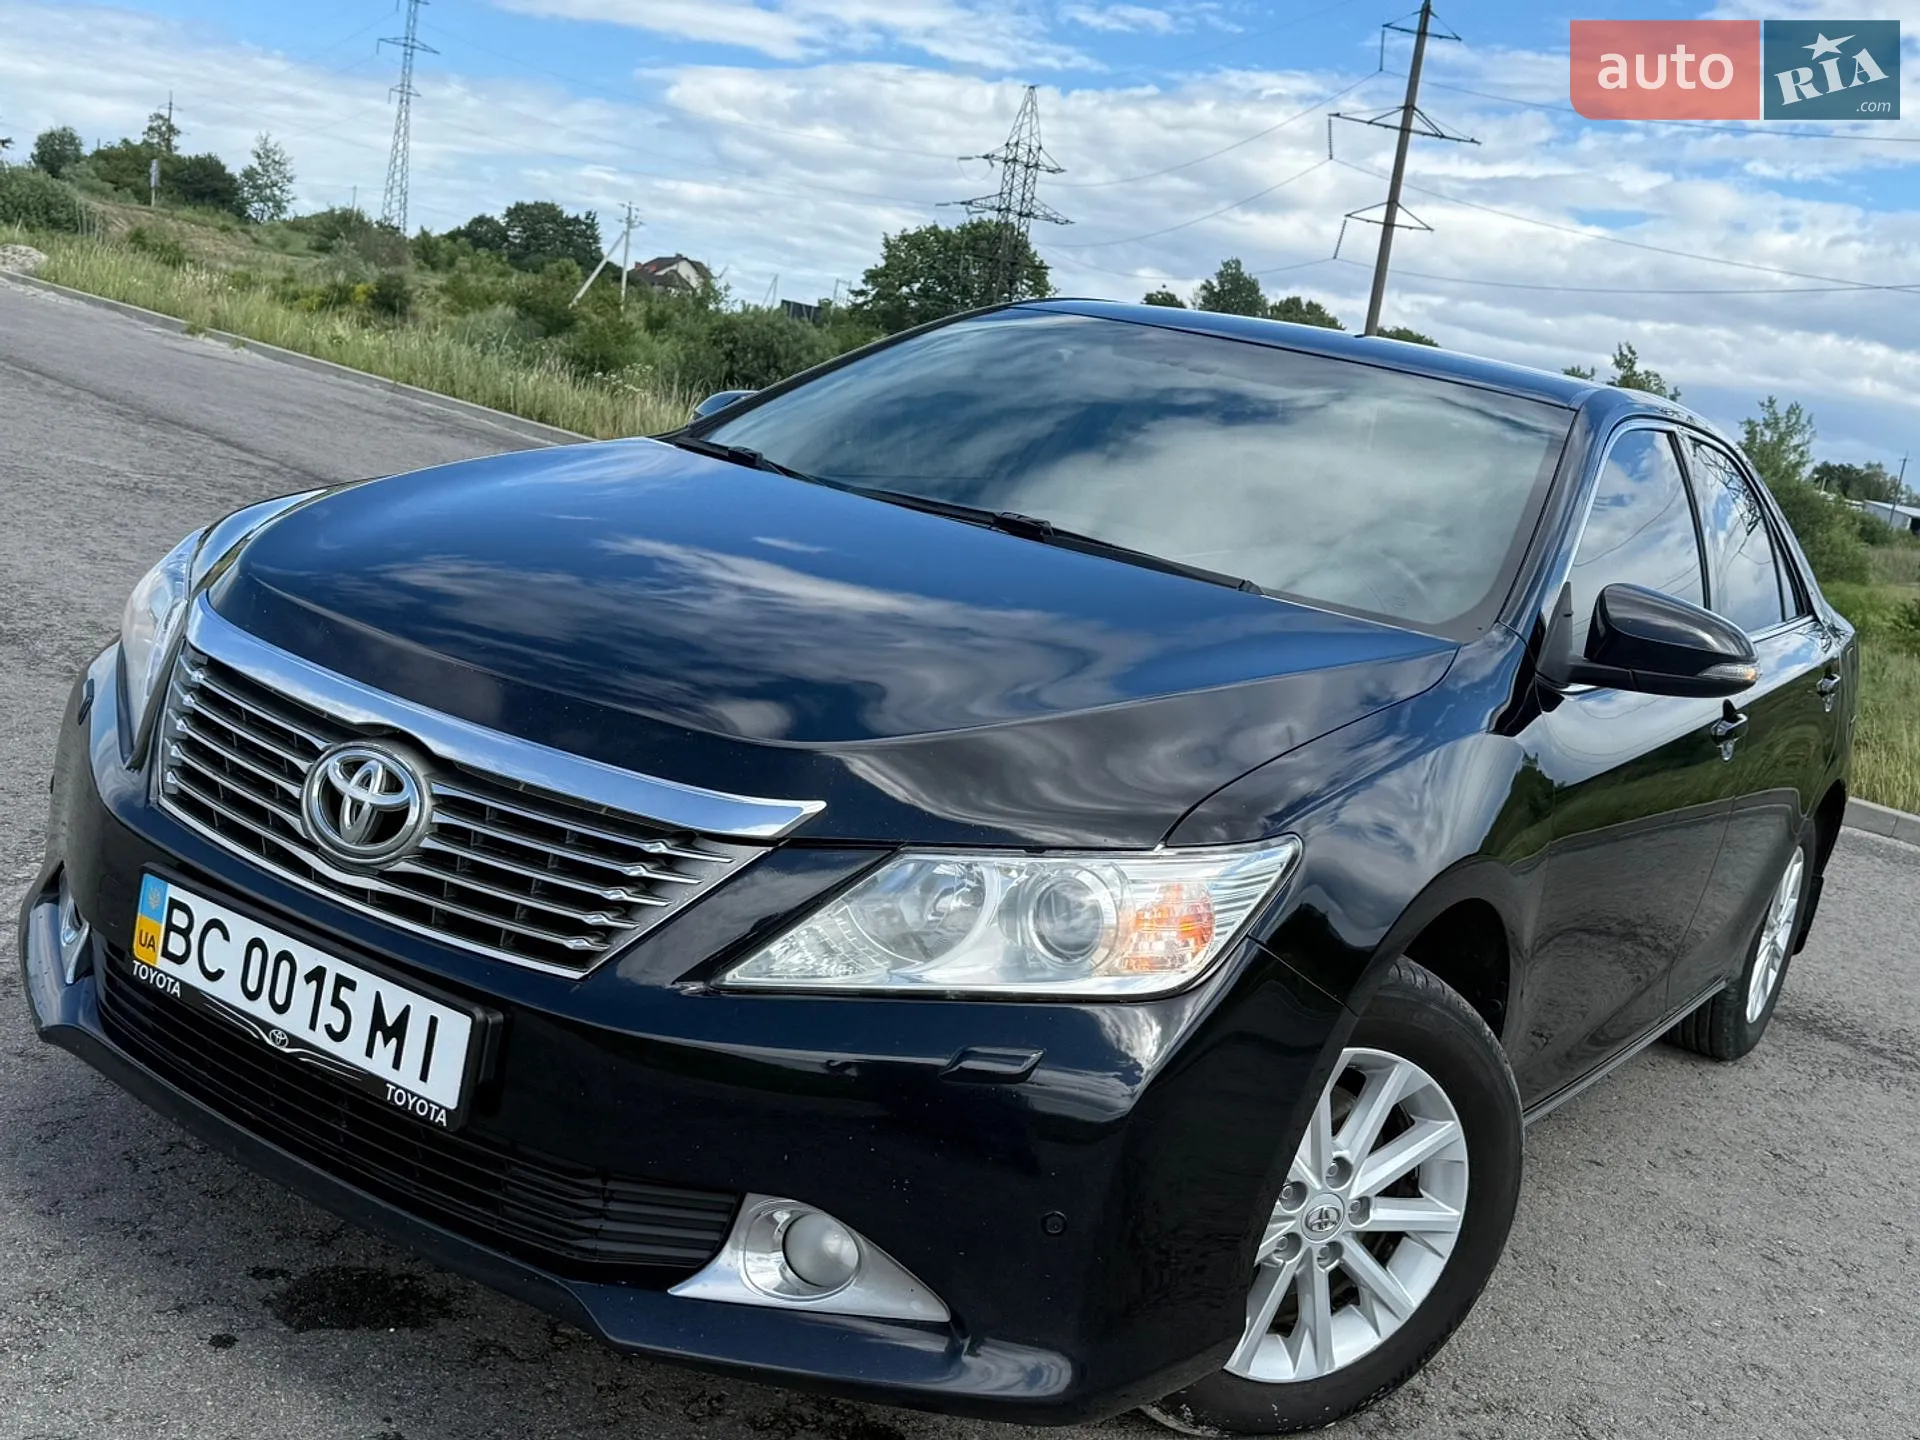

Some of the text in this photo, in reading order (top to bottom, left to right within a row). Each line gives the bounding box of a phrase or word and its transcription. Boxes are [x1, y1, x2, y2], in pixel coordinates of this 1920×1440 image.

[138, 931, 157, 952] UA
[132, 959, 181, 998] TOYOTA
[161, 896, 439, 1084] BC 0015 MI
[386, 1082, 447, 1127] TOYOTA
